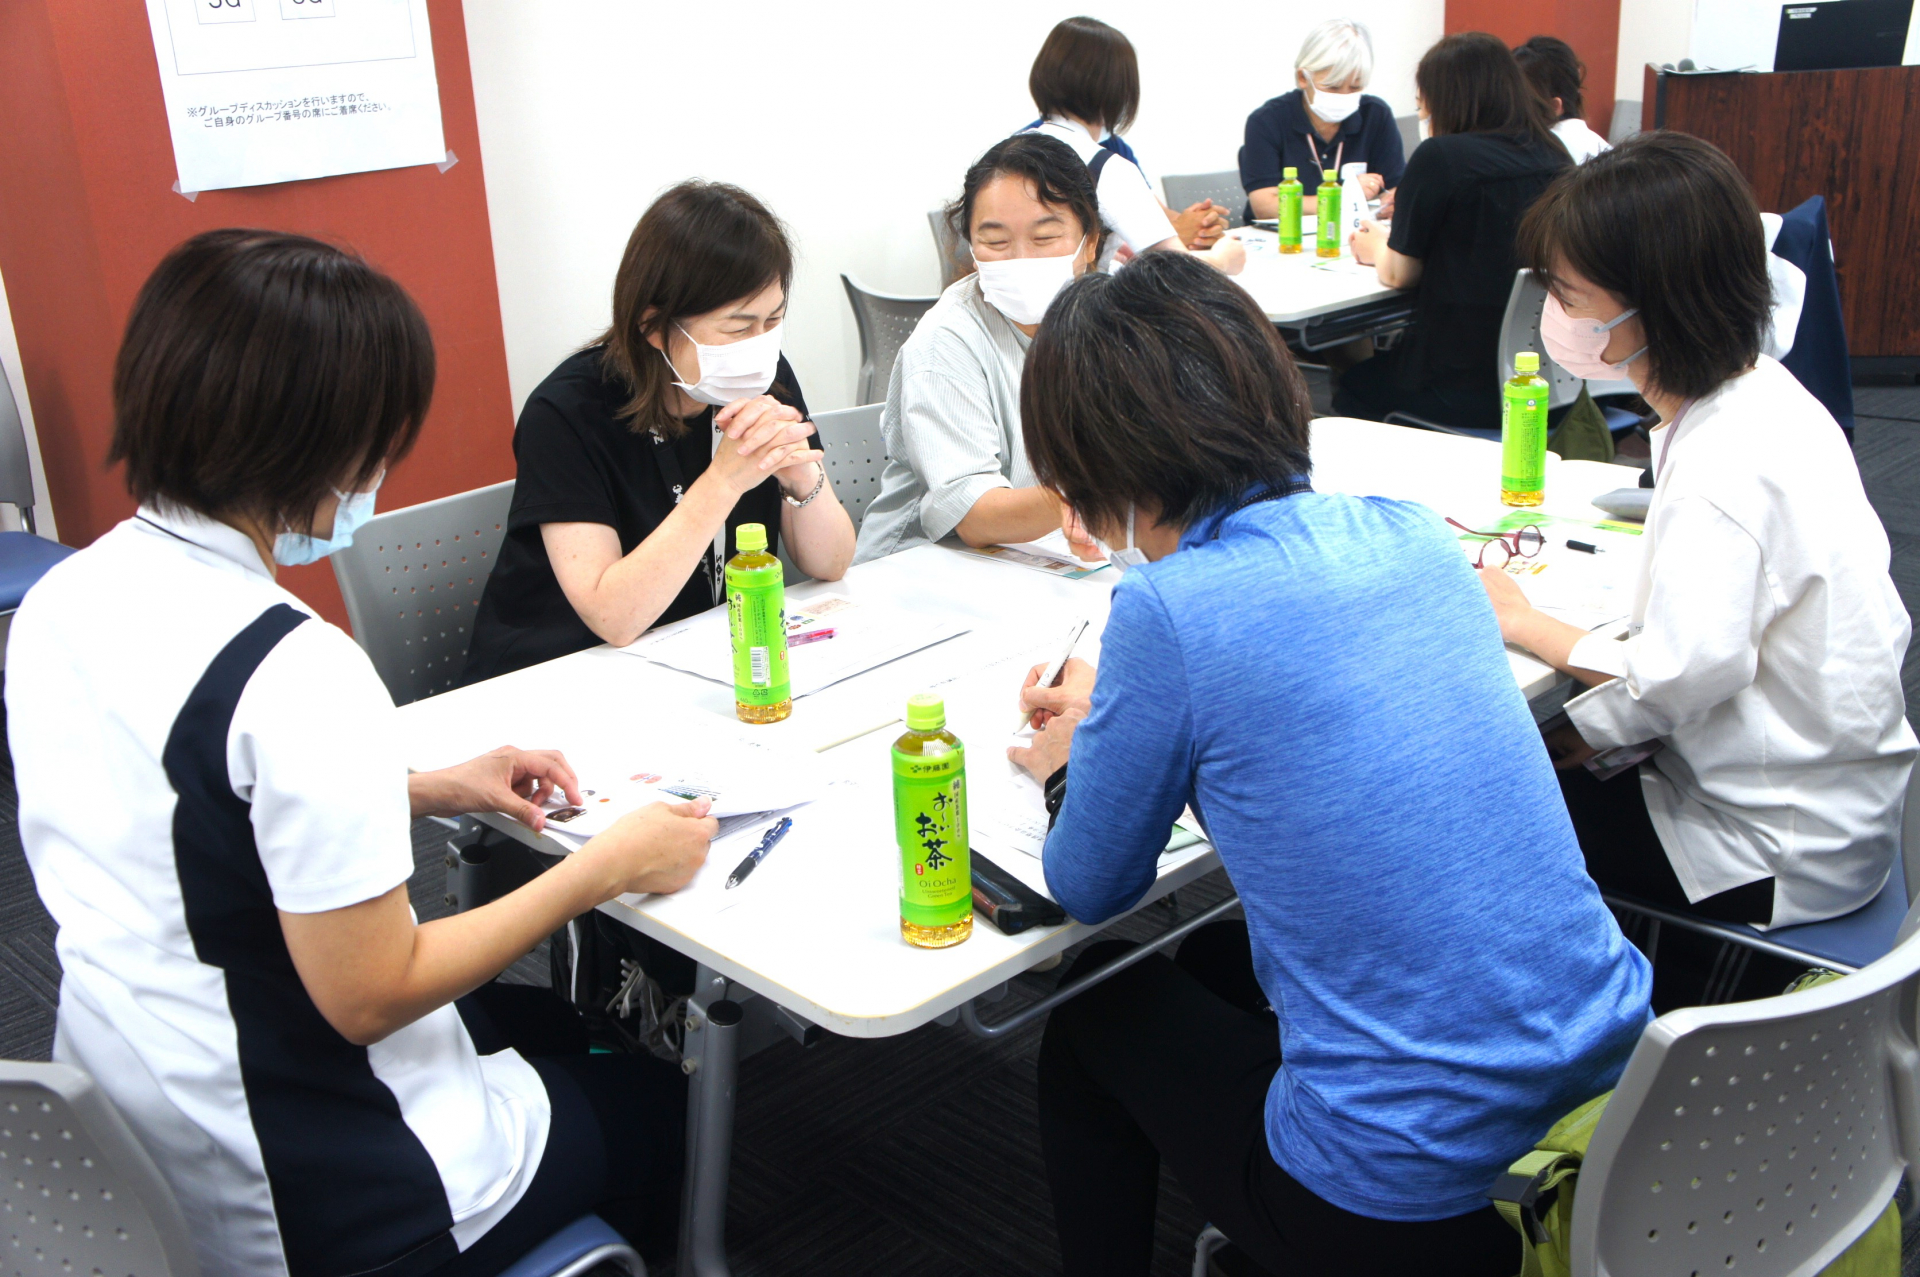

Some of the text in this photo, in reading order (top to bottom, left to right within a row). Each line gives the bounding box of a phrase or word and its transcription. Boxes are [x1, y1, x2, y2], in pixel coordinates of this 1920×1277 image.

[923, 762, 950, 773] 伊藤園
[915, 811, 953, 870] お茶
[919, 877, 957, 888] Oi Ocha
